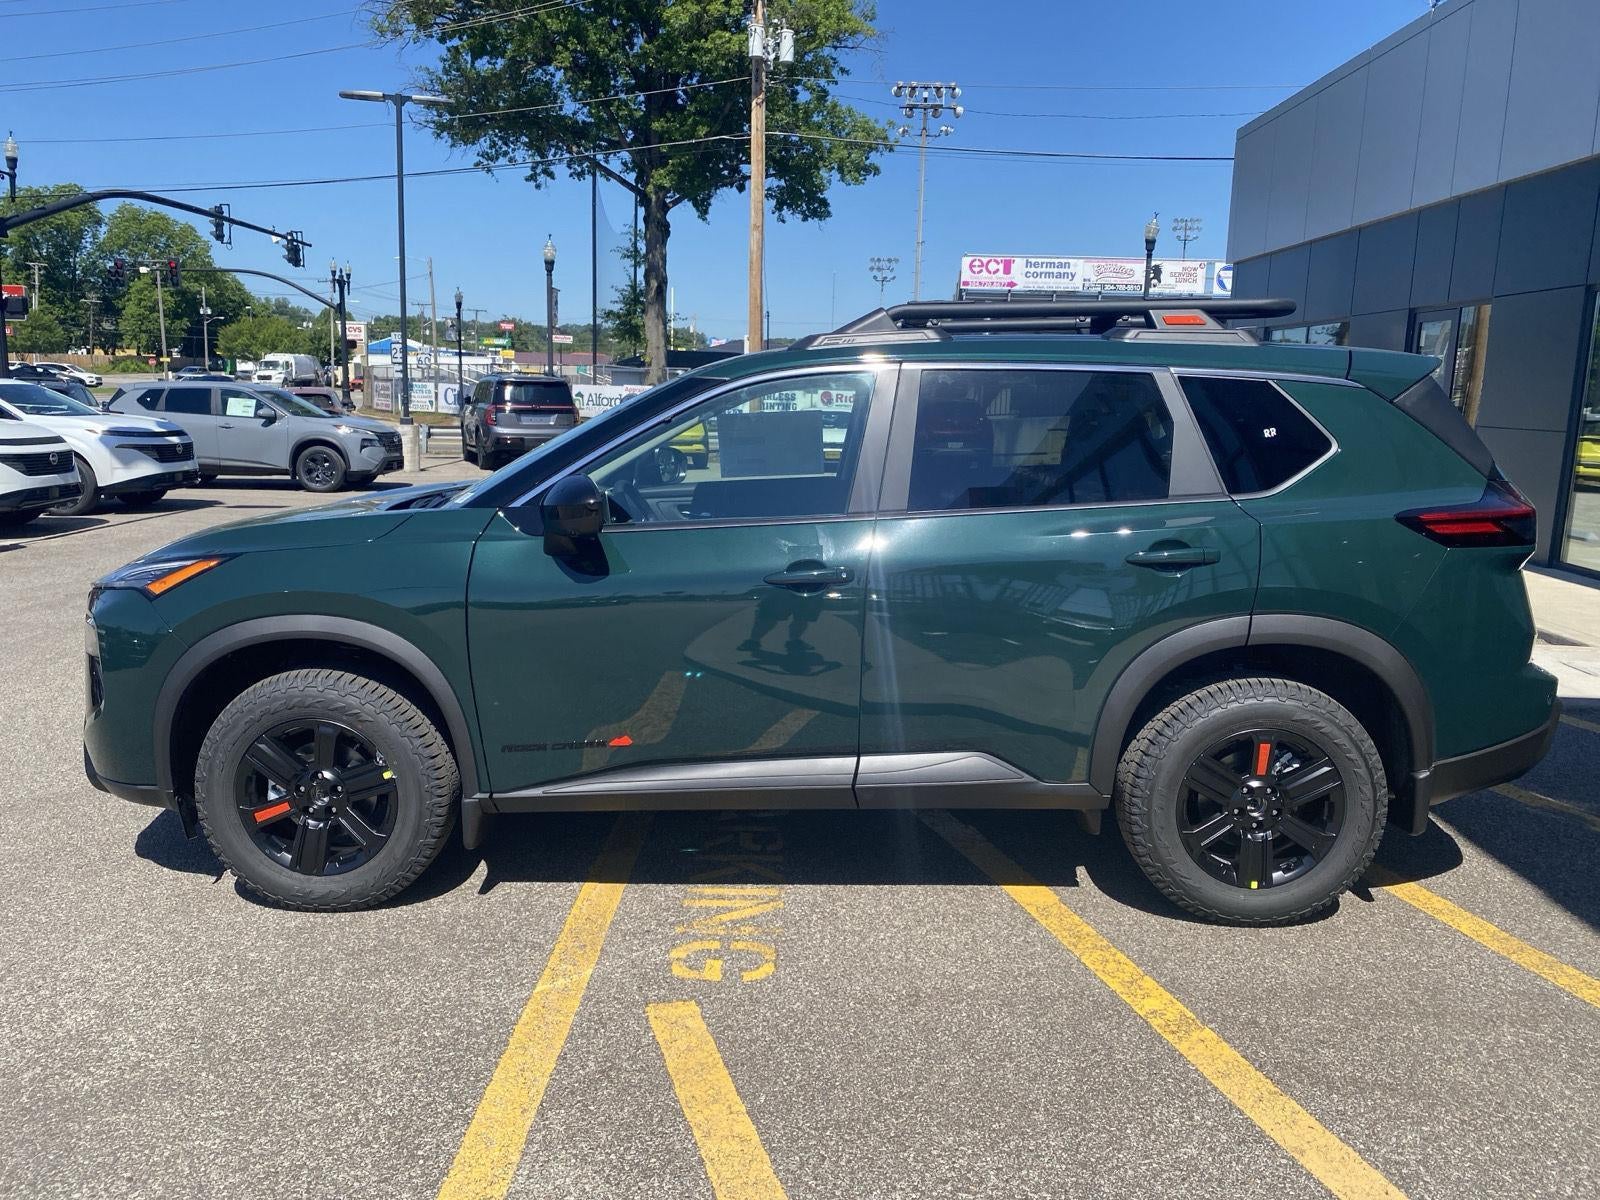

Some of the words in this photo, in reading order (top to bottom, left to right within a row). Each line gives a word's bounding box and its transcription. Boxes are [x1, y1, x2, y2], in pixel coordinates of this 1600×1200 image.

[1025, 259, 1071, 270] herman
[1024, 270, 1077, 282] cormany
[347, 326, 362, 334] CVS
[417, 356, 432, 366] 60
[586, 392, 622, 407] Alford
[1263, 427, 1277, 438] RR
